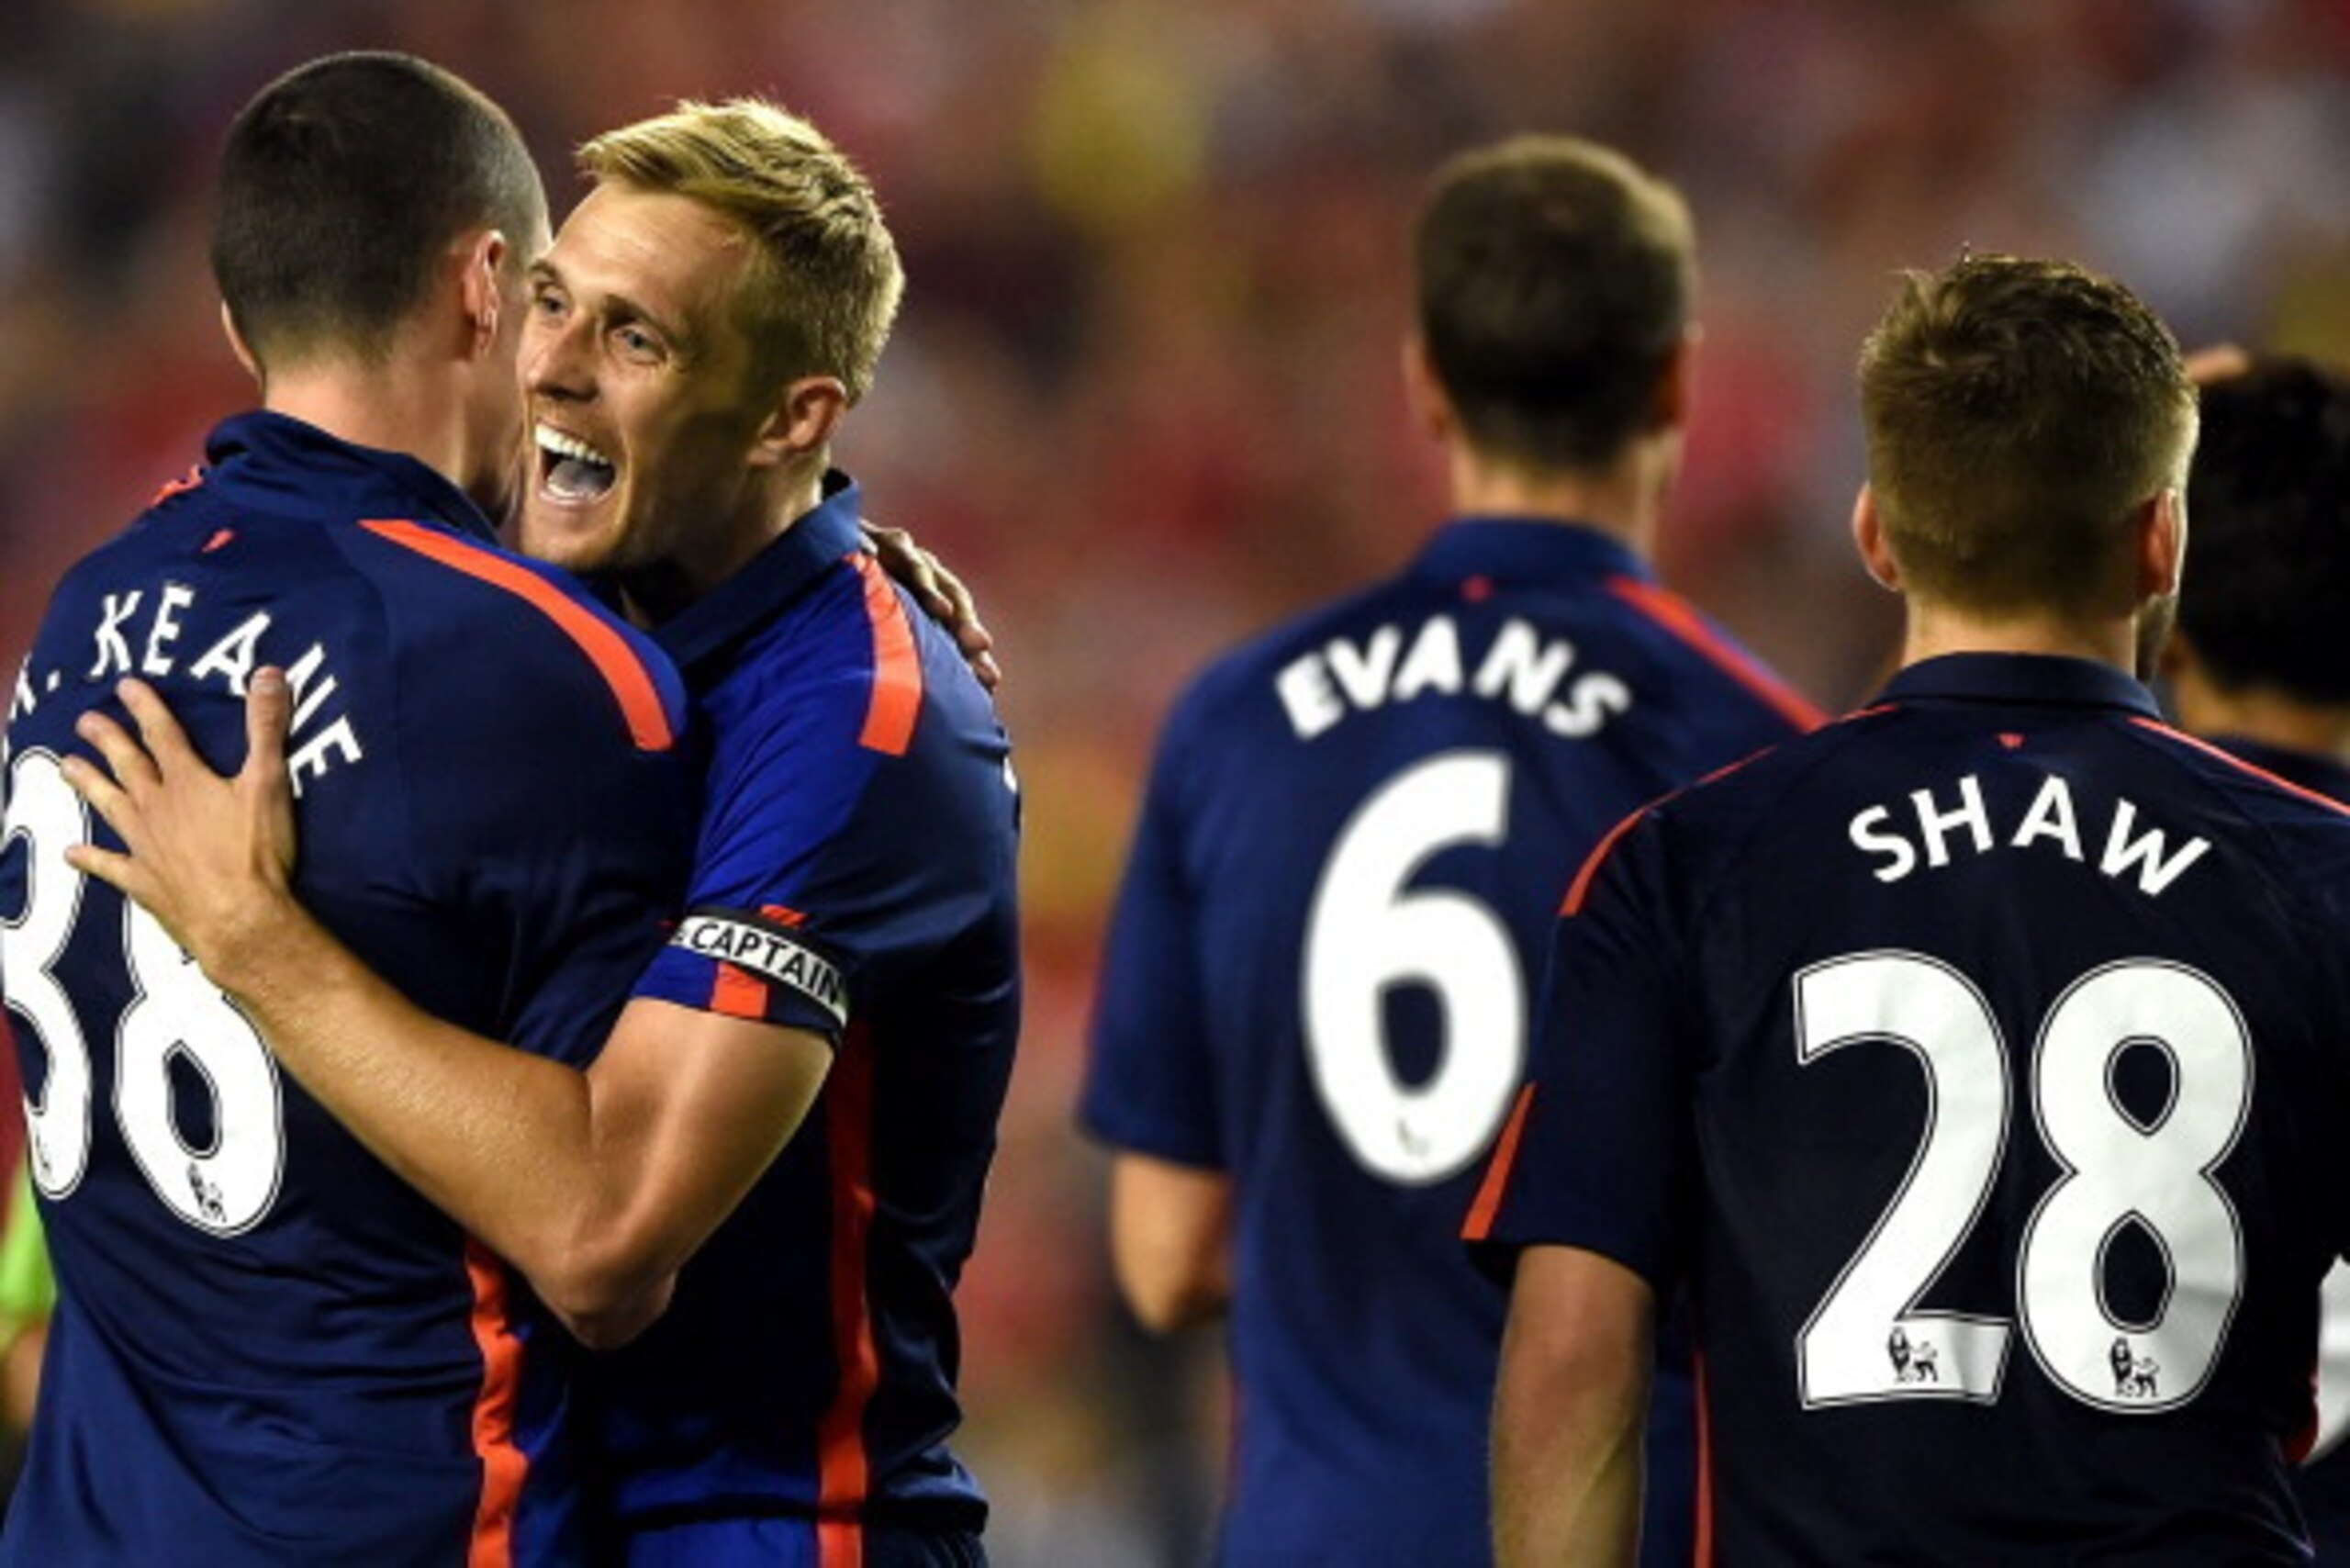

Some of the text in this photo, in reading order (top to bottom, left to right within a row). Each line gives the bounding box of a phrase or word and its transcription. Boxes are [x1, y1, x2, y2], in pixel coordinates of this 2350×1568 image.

[89, 581, 363, 798] KEANE
[1275, 614, 1631, 740] EVANS
[1847, 773, 2212, 897] SHAW
[690, 922, 845, 1006] CAPTAIN
[1301, 748, 1528, 1187] 6
[1792, 947, 2256, 1416] 28
